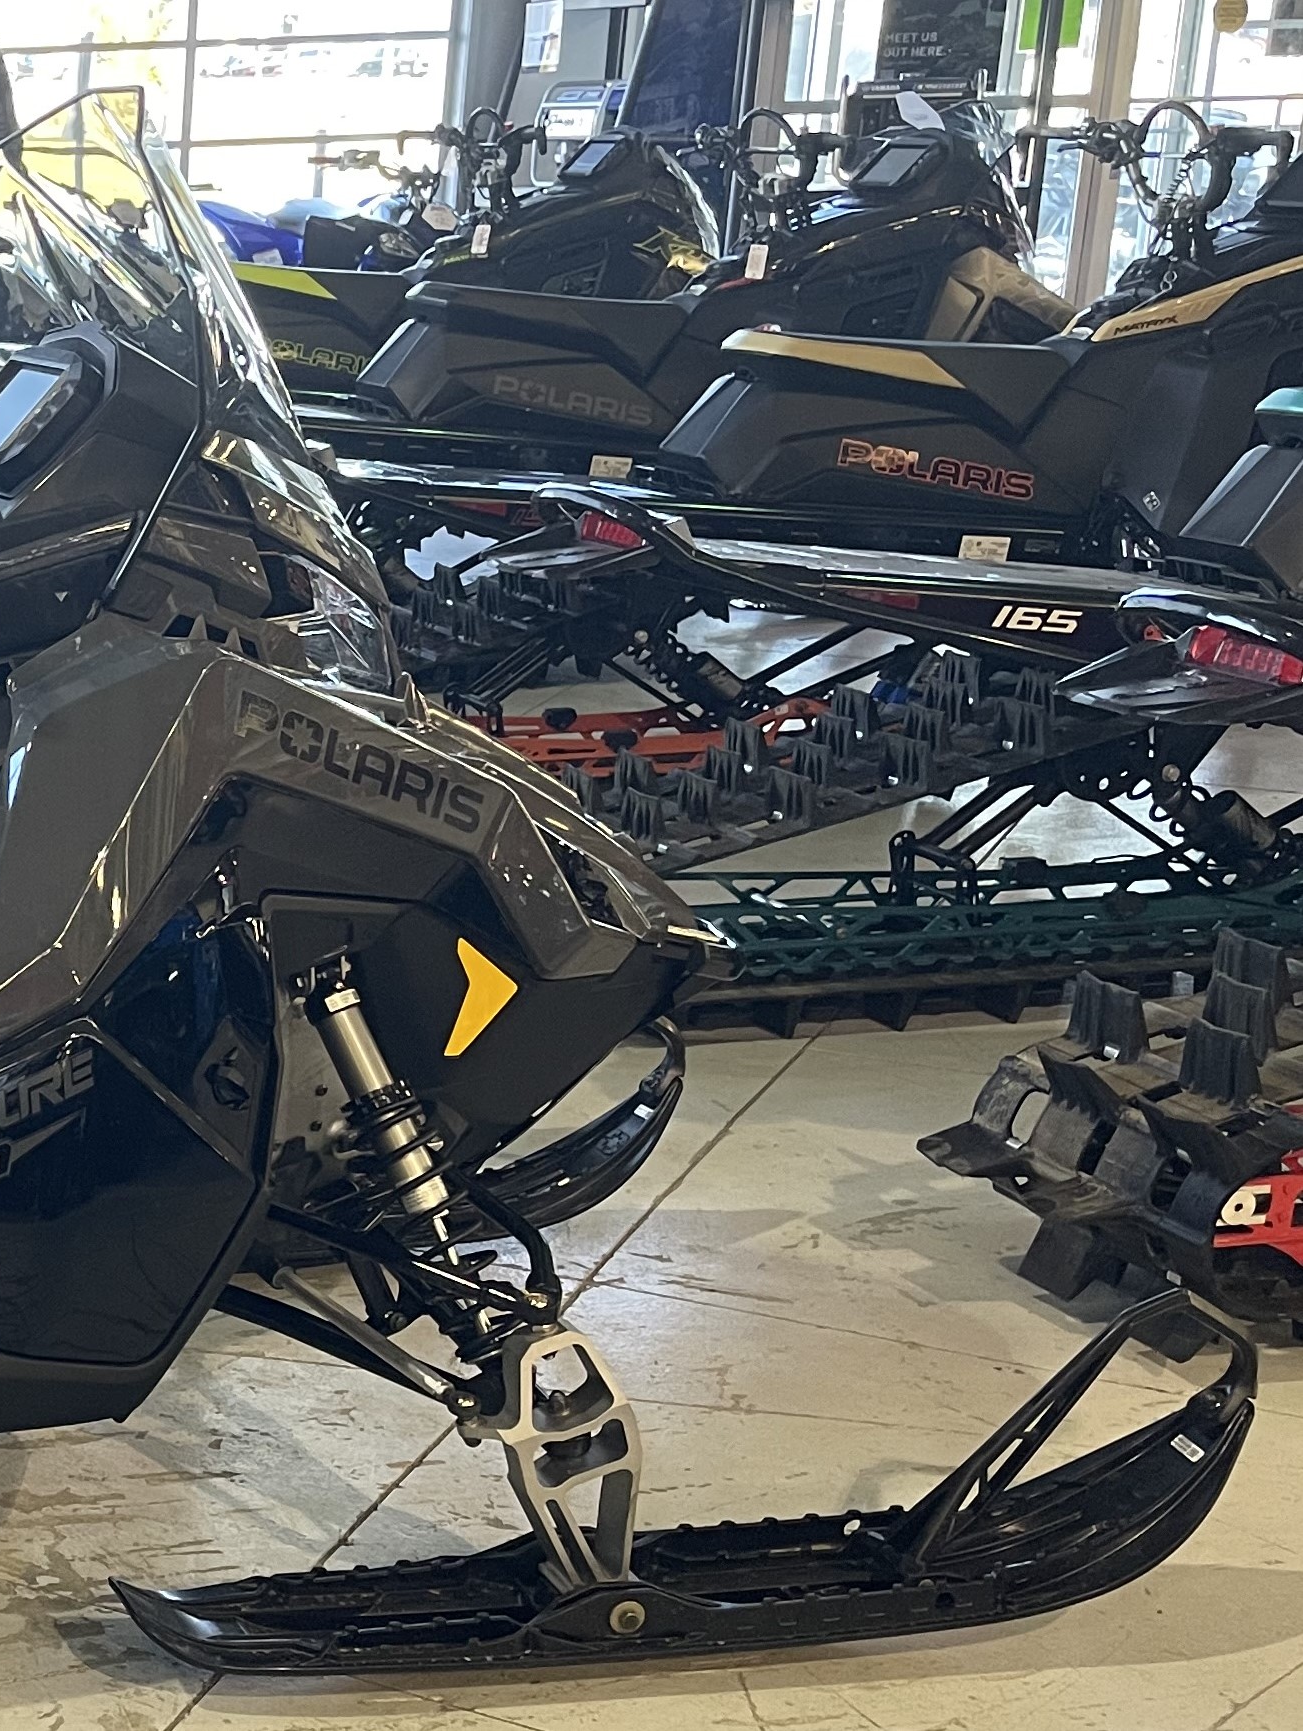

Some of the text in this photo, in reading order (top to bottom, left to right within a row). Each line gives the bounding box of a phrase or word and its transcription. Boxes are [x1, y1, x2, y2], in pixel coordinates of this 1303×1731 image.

[884, 46, 910, 58] OUT
[886, 31, 938, 44] MEET US
[1113, 315, 1179, 336] MATRYX
[271, 338, 371, 375] OLARI
[493, 373, 653, 427] POLARIS
[837, 437, 1035, 501] POLARIS
[991, 605, 1083, 634] 165
[234, 689, 485, 834] POLARIS
